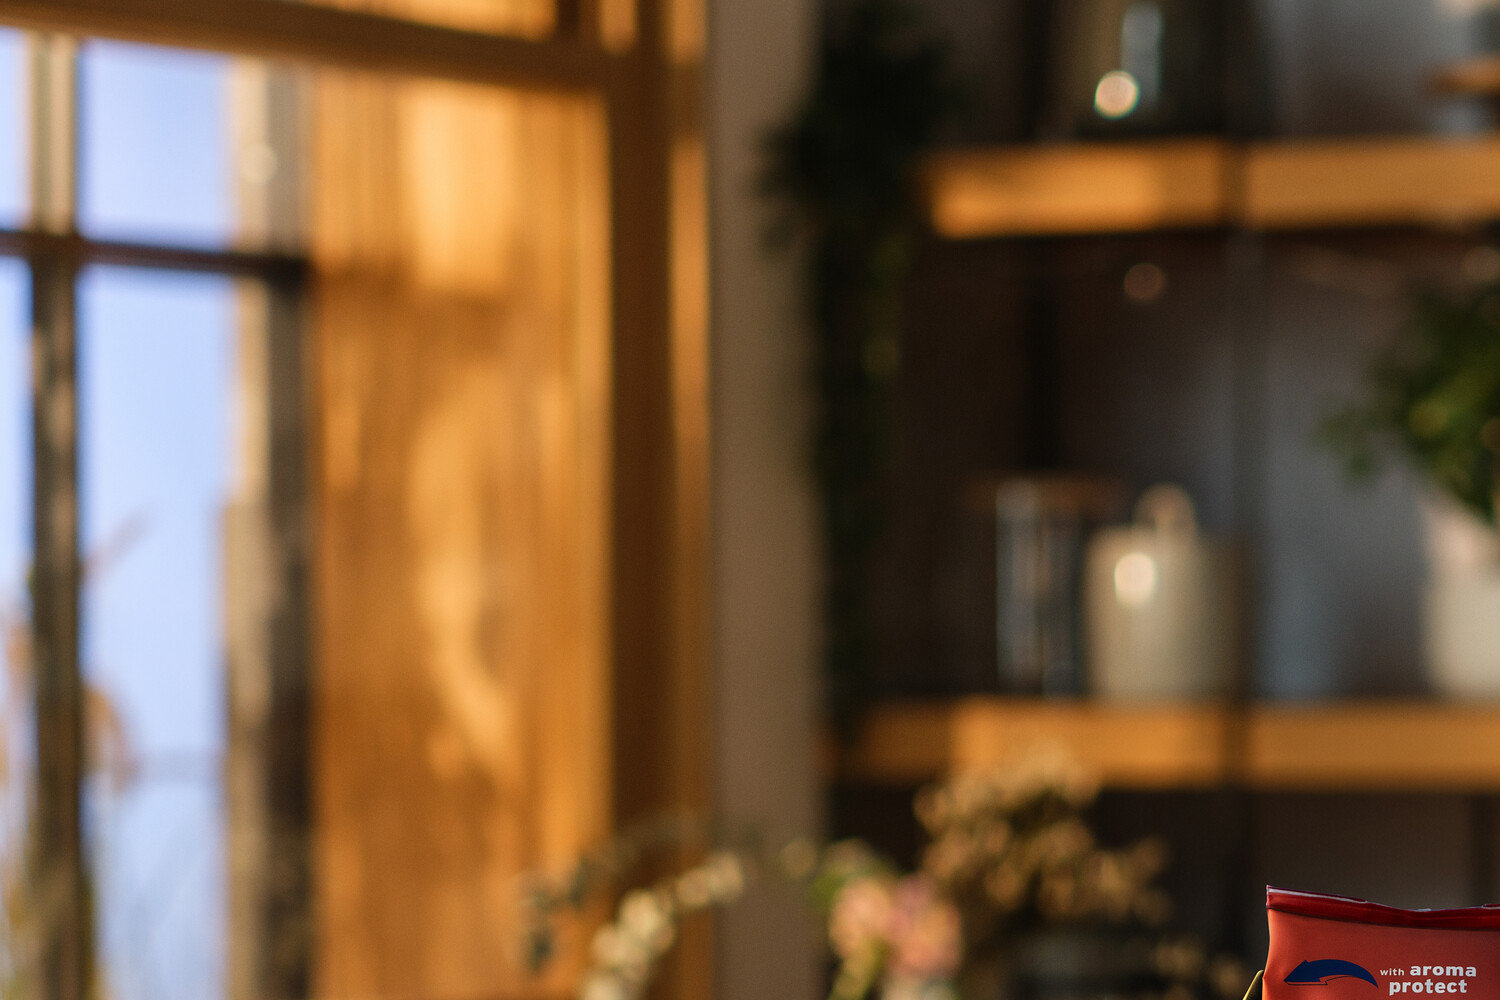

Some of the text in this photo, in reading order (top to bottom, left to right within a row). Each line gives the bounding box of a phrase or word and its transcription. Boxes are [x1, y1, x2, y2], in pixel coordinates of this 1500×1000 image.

[1380, 965, 1477, 977] with aroma
[1389, 978, 1467, 996] protect
